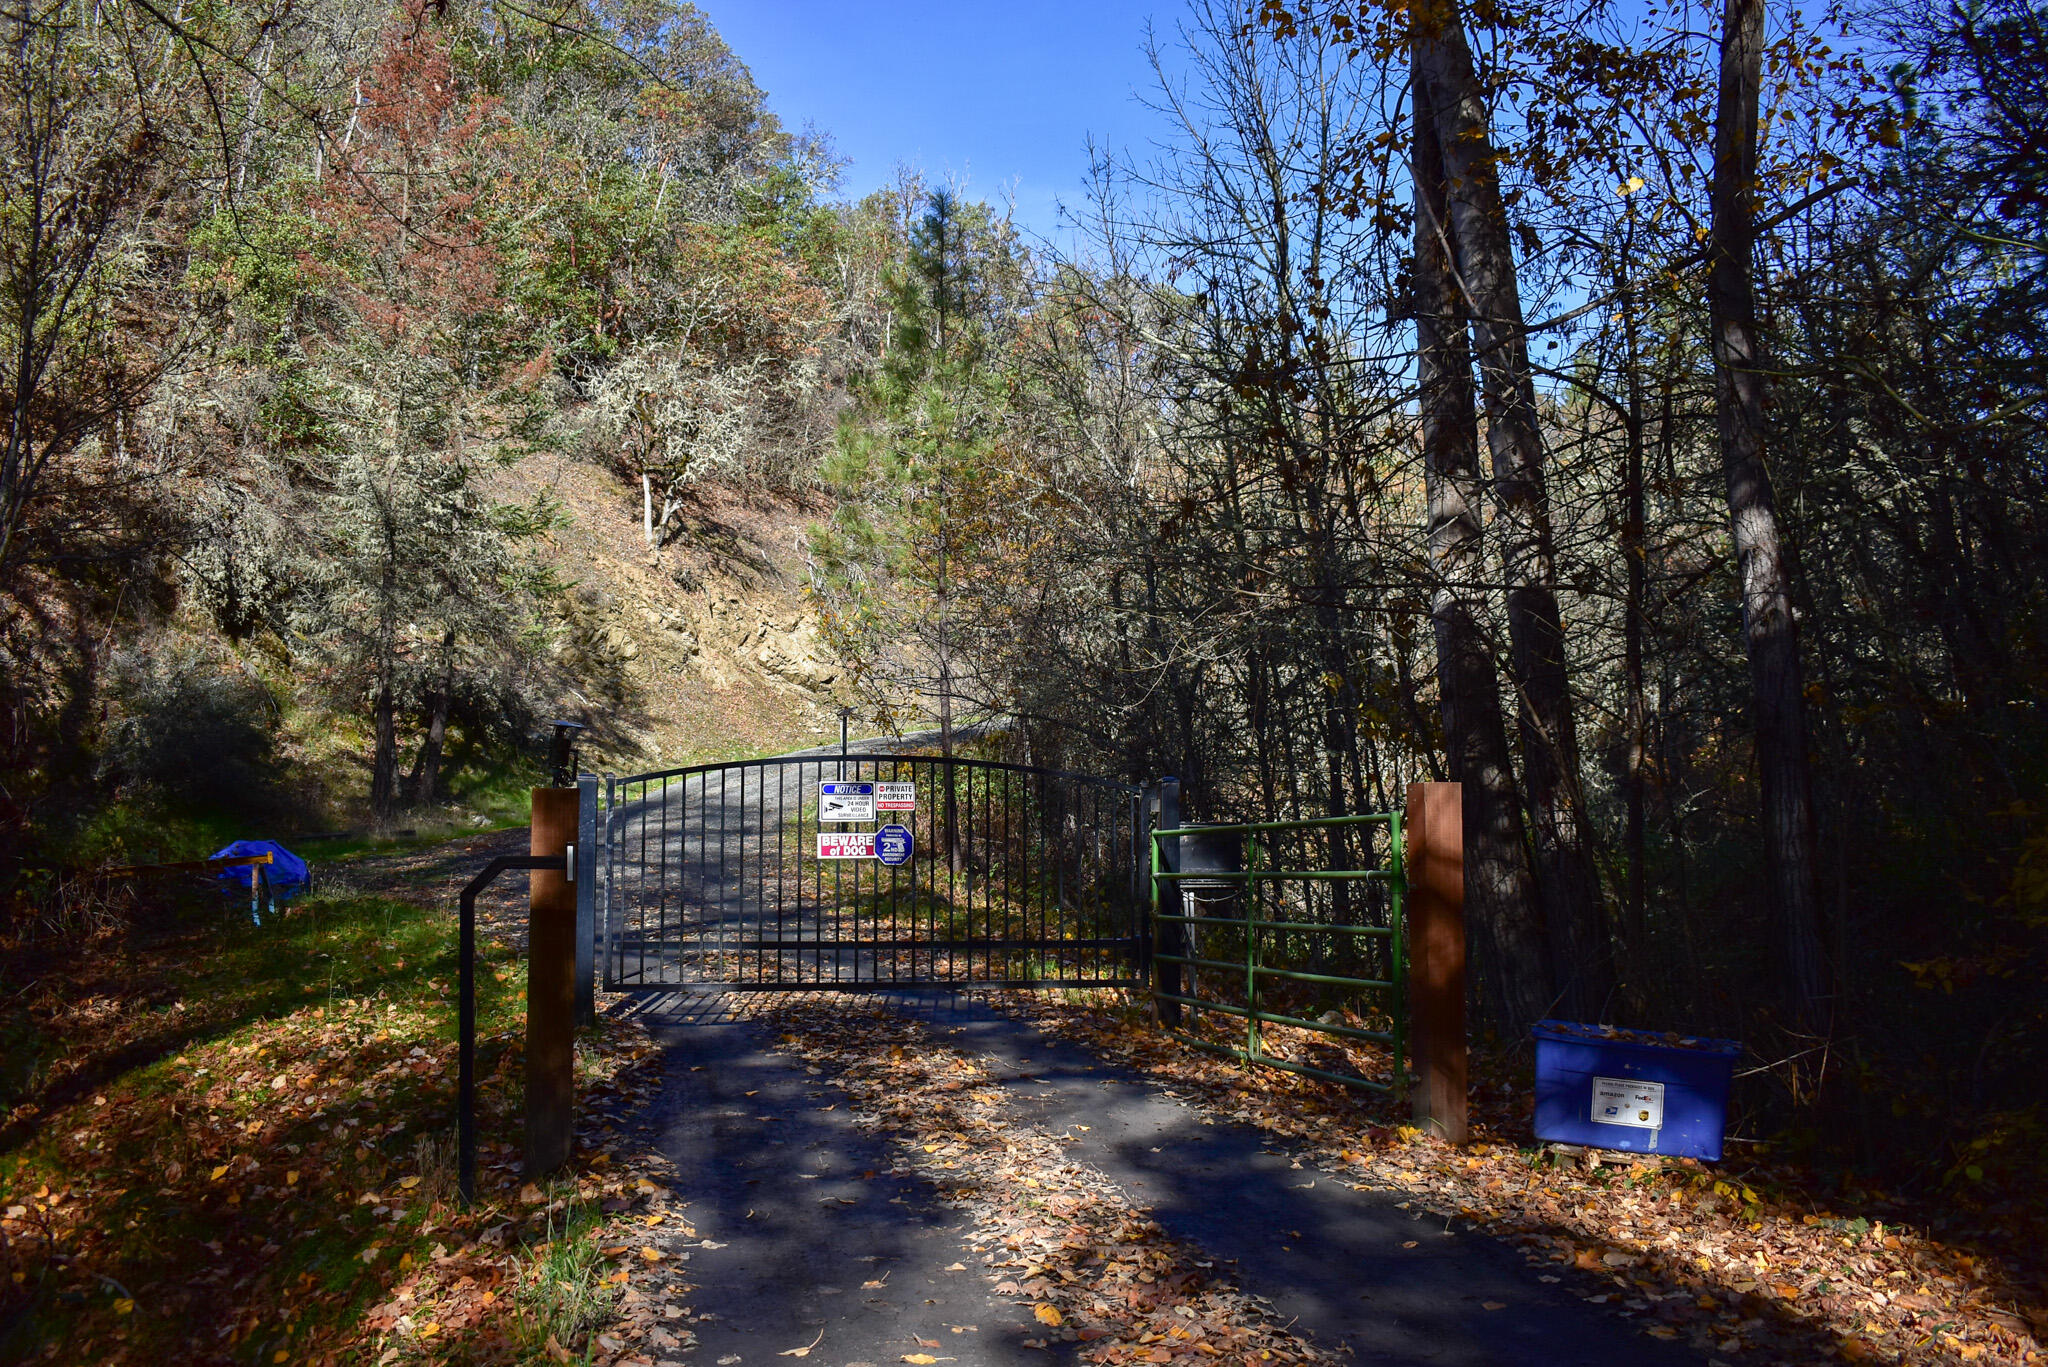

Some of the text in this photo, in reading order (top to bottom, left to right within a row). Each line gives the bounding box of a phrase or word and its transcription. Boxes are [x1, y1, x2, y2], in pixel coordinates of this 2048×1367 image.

[834, 785, 862, 794] NOTICE
[822, 836, 874, 846] BEWARE
[830, 846, 867, 855] of DOG
